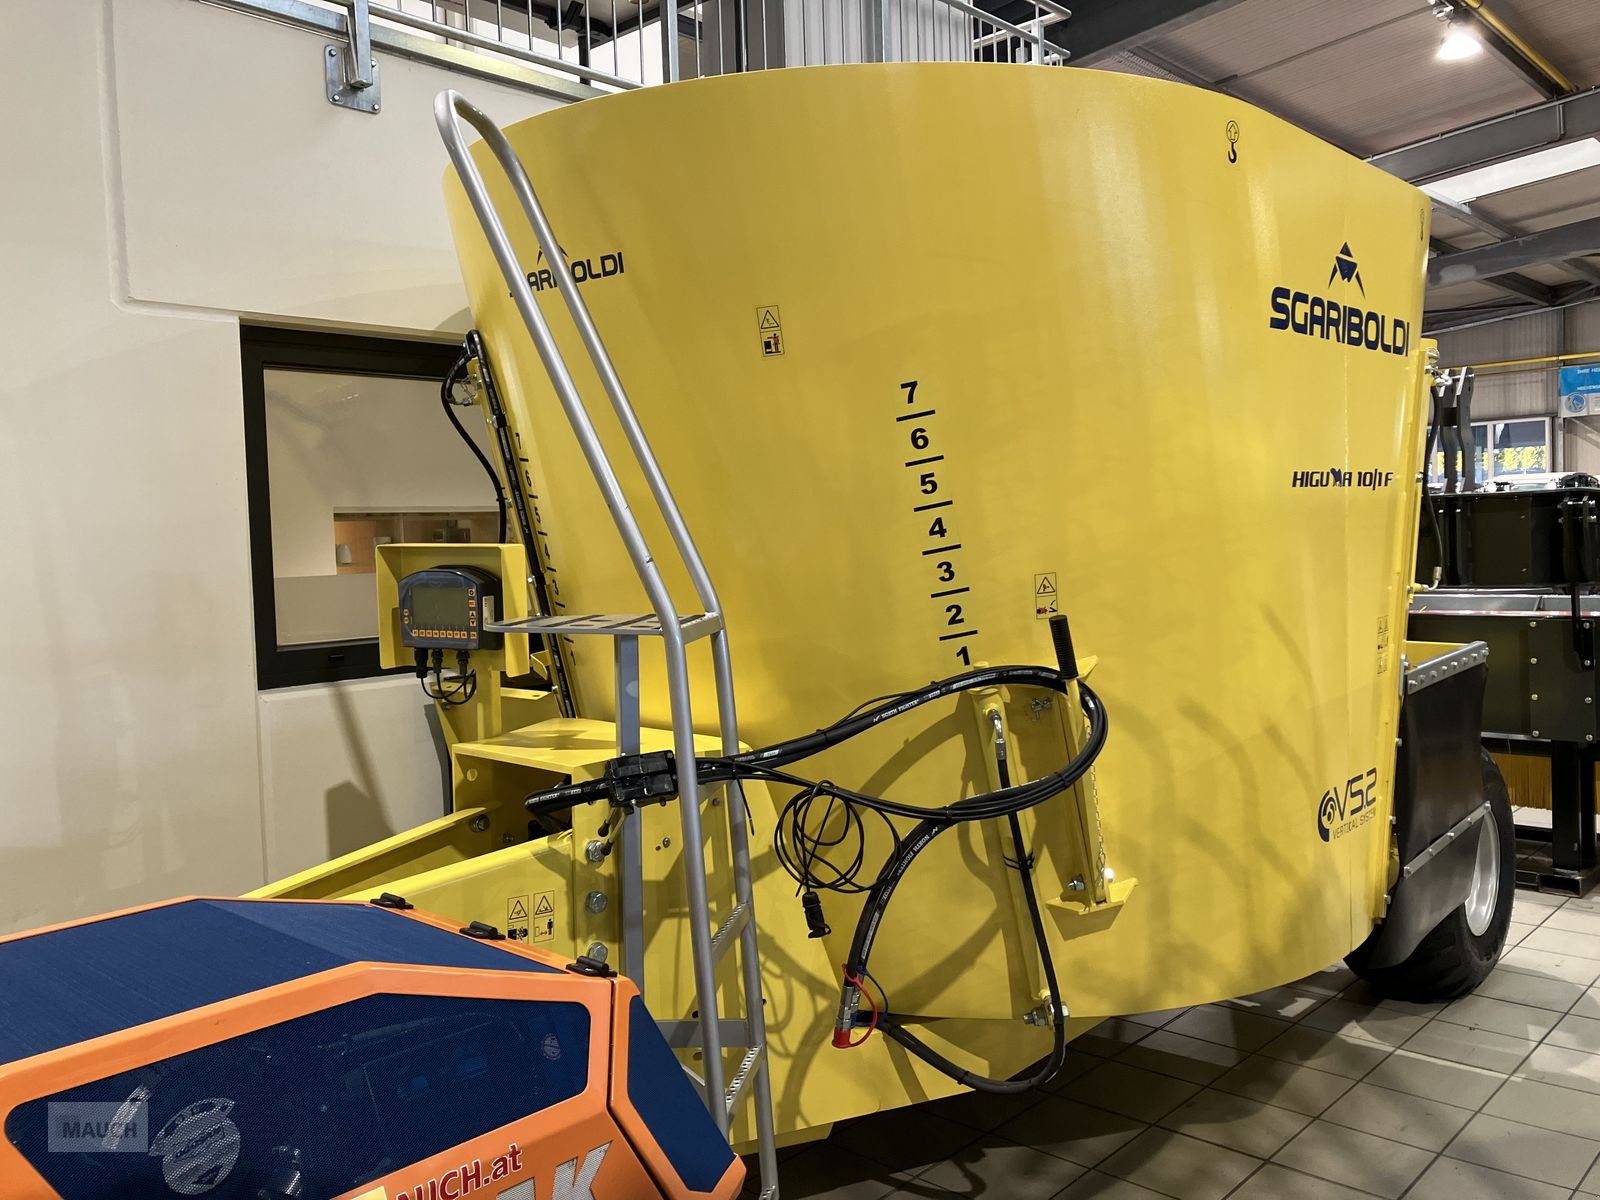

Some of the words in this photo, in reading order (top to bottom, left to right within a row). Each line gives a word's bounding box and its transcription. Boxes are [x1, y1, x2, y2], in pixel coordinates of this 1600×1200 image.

[1269, 286, 1410, 357] SGARIBOLDI
[900, 381, 918, 404] 7
[911, 428, 929, 450] 6
[920, 472, 938, 495] 5
[929, 517, 947, 538] 4
[937, 561, 955, 582] 3
[945, 604, 965, 626] 2
[956, 646, 970, 666] 1
